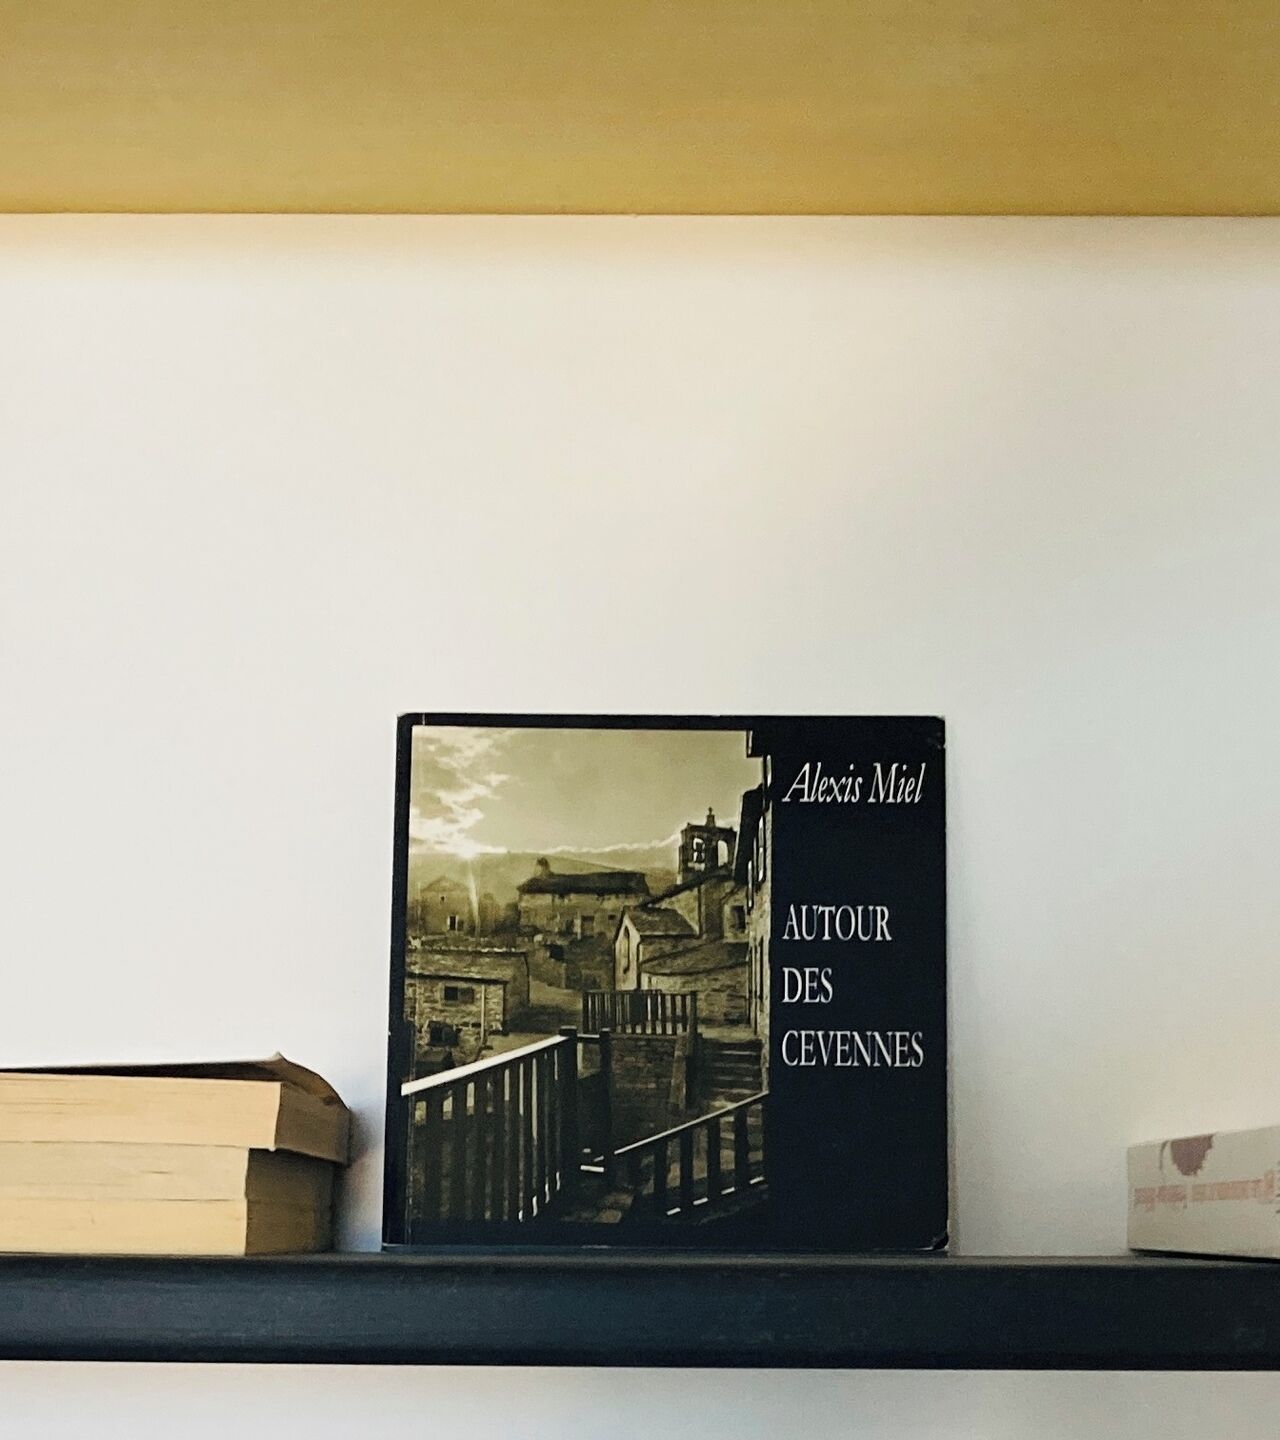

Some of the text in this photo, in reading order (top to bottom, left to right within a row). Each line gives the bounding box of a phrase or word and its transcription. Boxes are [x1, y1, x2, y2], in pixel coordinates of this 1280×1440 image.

[781, 761, 927, 805] Alexis Miel
[782, 904, 893, 941] AUTOUR
[782, 966, 834, 1004] DES
[781, 1030, 925, 1067] CEVENNES
